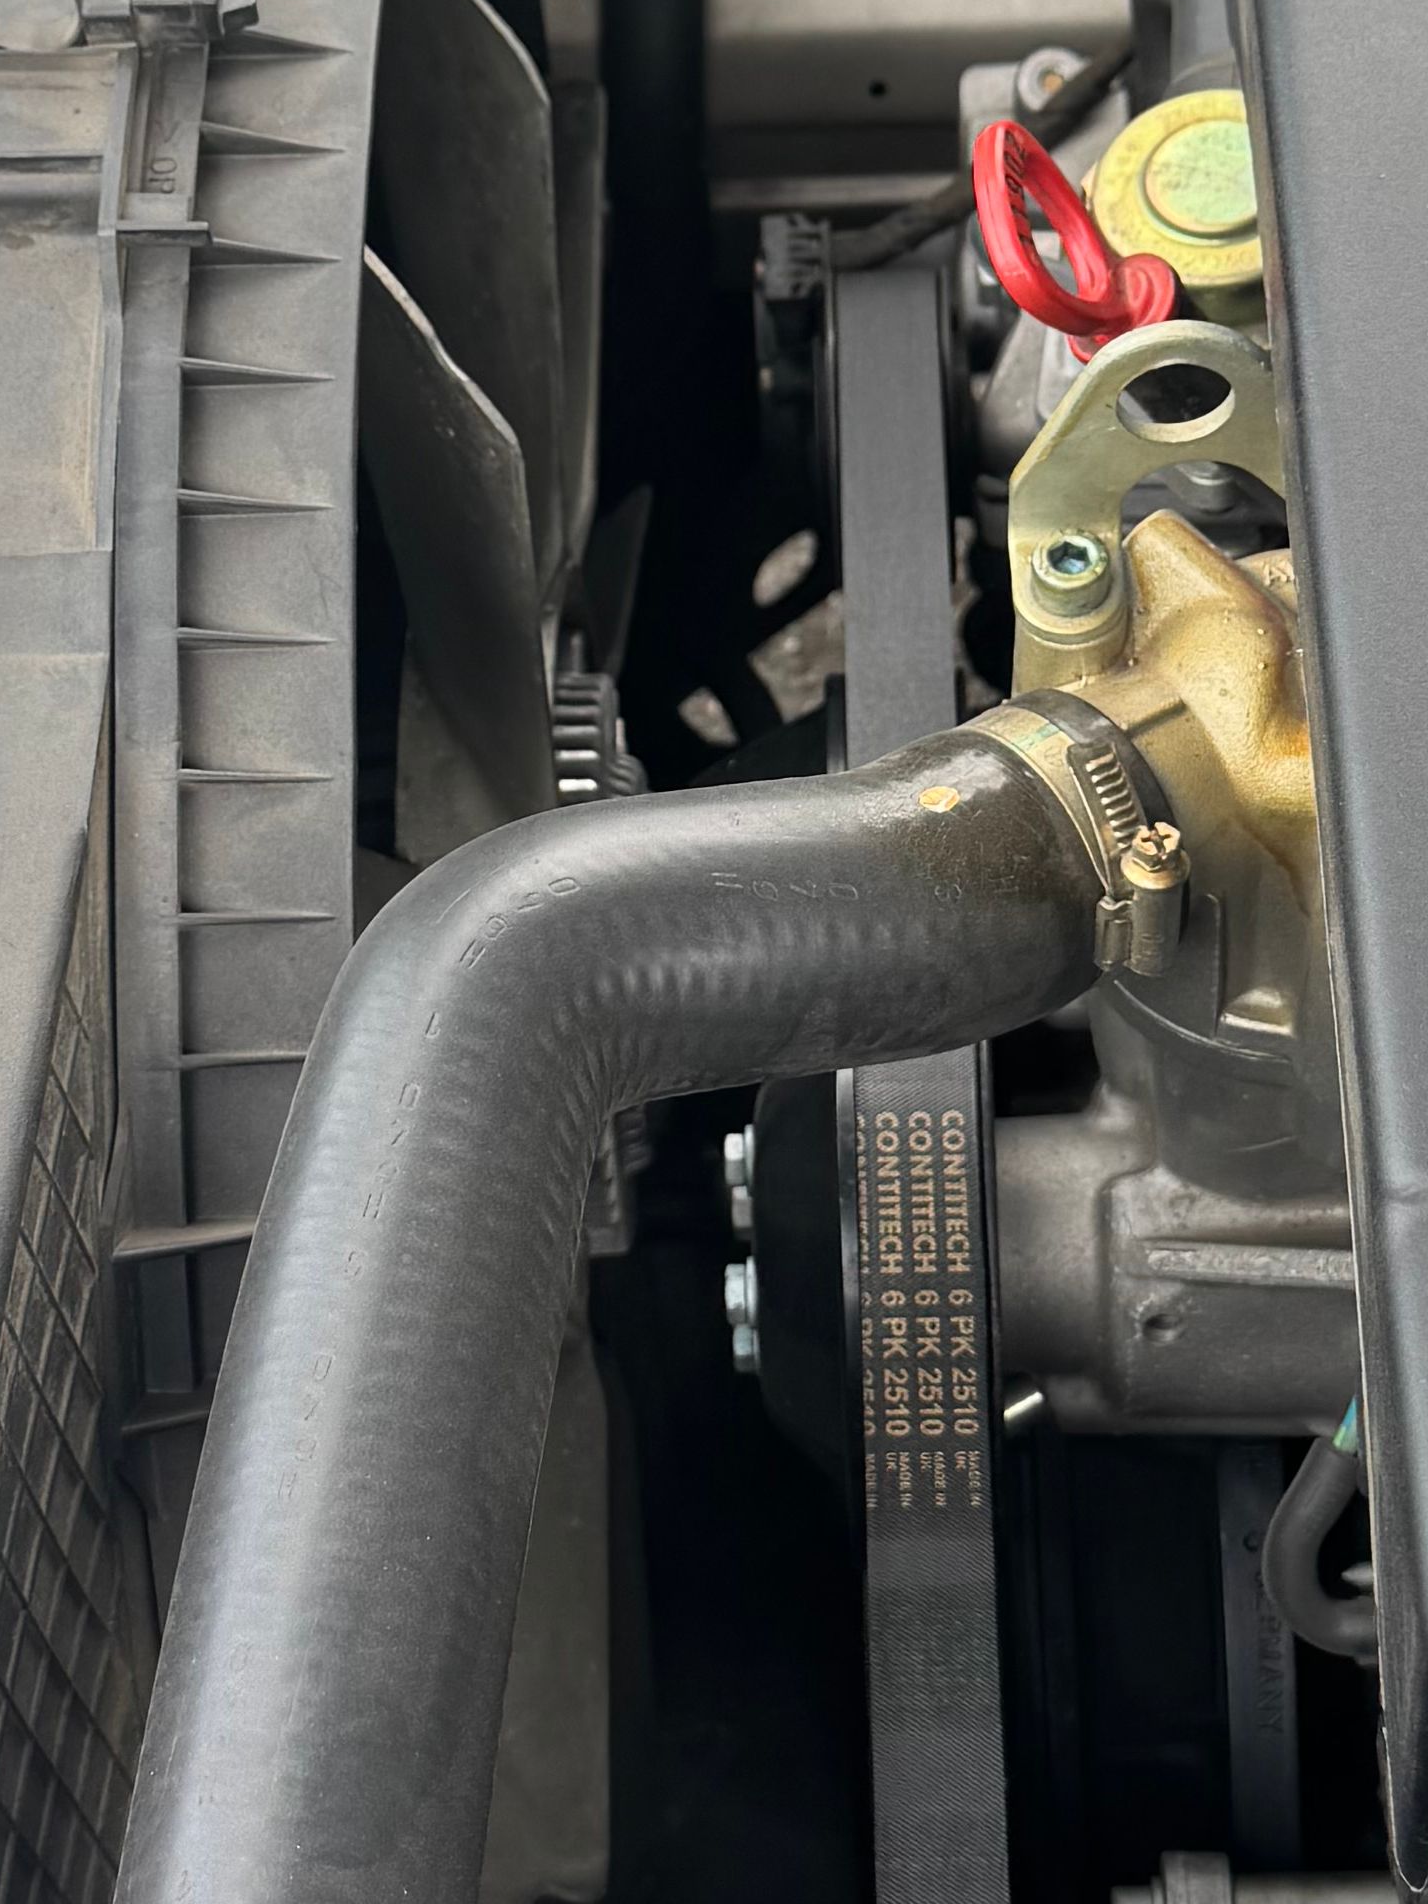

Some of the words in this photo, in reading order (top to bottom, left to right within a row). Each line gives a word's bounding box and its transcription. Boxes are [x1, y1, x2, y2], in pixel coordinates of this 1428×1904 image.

[875, 1110, 905, 1274] CONTITECH
[908, 1110, 939, 1274] CONTITECH
[942, 1110, 973, 1274] CONTITECH
[881, 1290, 905, 1307] 6
[914, 1290, 939, 1307] 6
[950, 1290, 972, 1307] 6
[882, 1315, 908, 1358] PK
[915, 1315, 941, 1358] PK
[950, 1315, 976, 1358] PK
[884, 1368, 911, 1437] 2510
[917, 1368, 944, 1437] 2510
[953, 1368, 978, 1437] 2510
